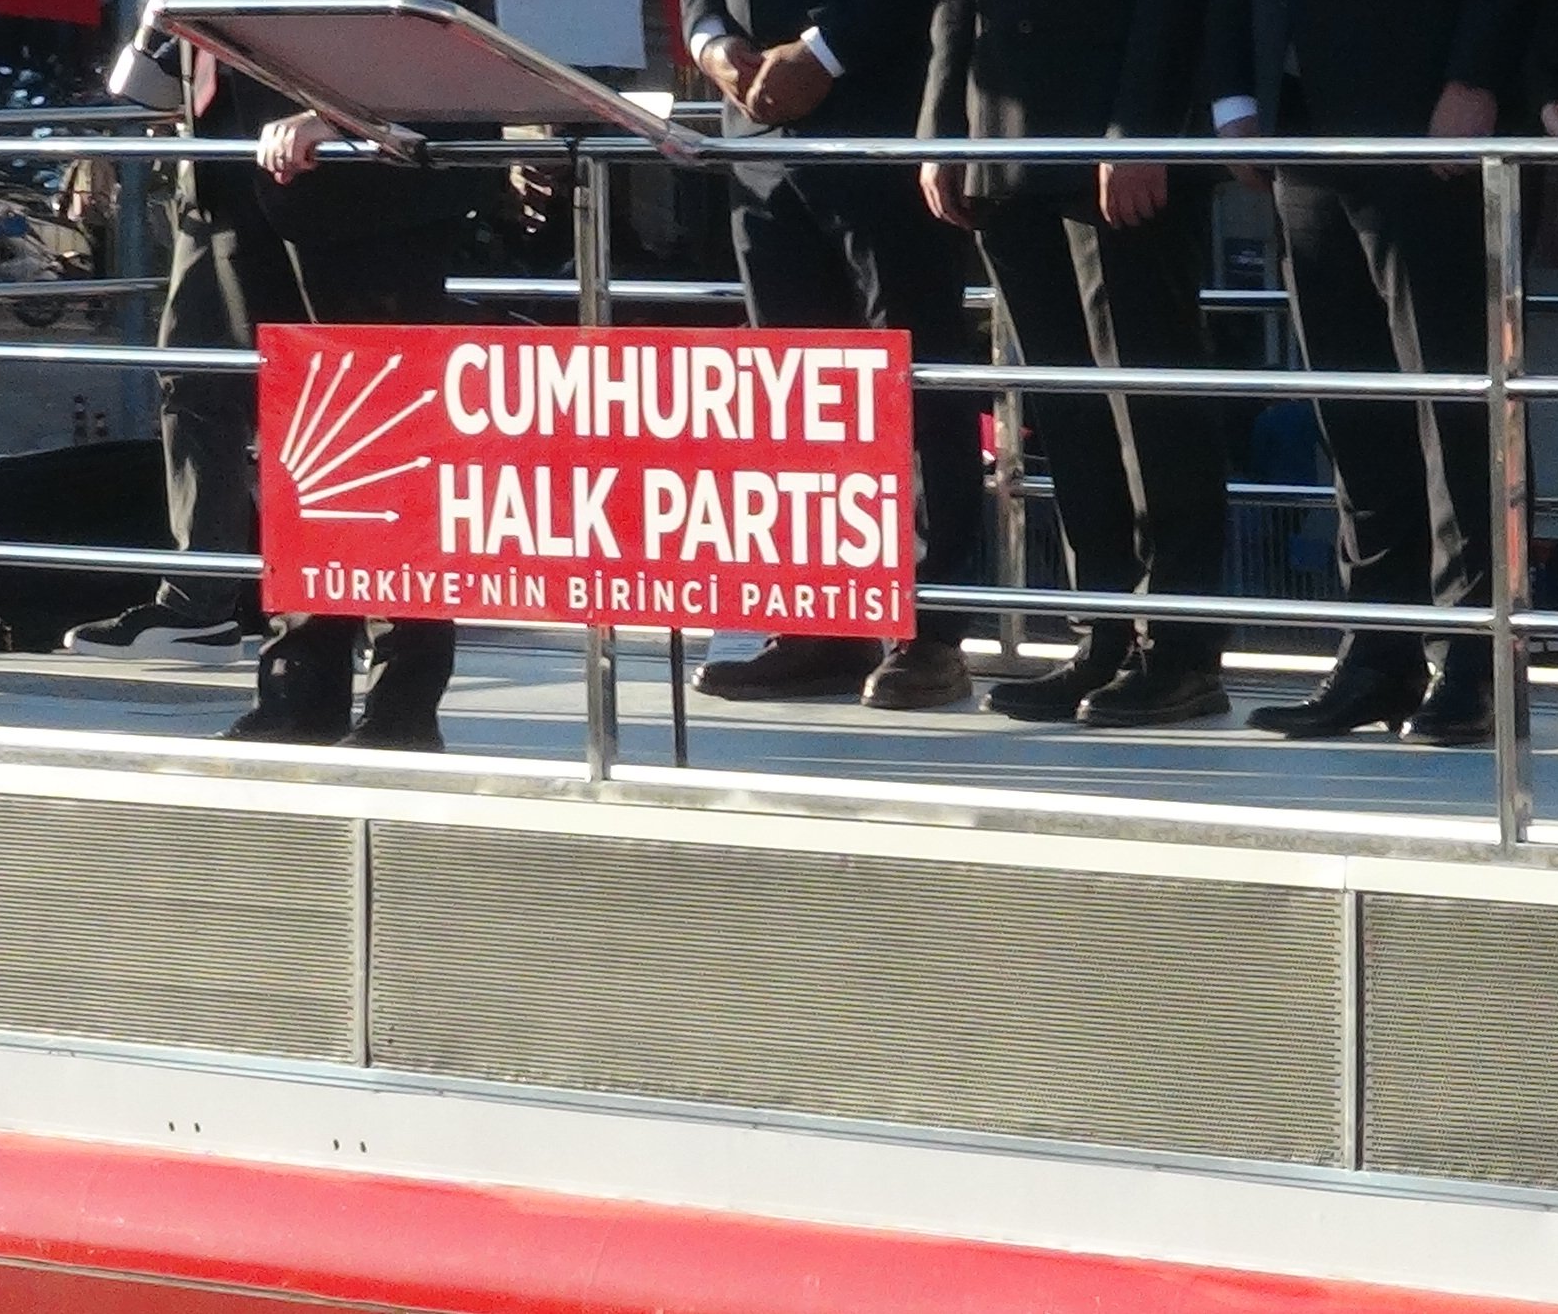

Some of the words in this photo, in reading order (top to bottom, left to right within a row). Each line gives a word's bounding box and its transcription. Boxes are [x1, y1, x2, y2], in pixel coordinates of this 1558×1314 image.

[443, 343, 889, 442] CUMHURİYET
[439, 463, 622, 559] HALK
[644, 468, 899, 569] PARTİSİ
[301, 561, 547, 610] TÜRKİYE'NİN
[568, 569, 721, 616] BİRİNCİ
[742, 578, 902, 623] PARTİSİ
